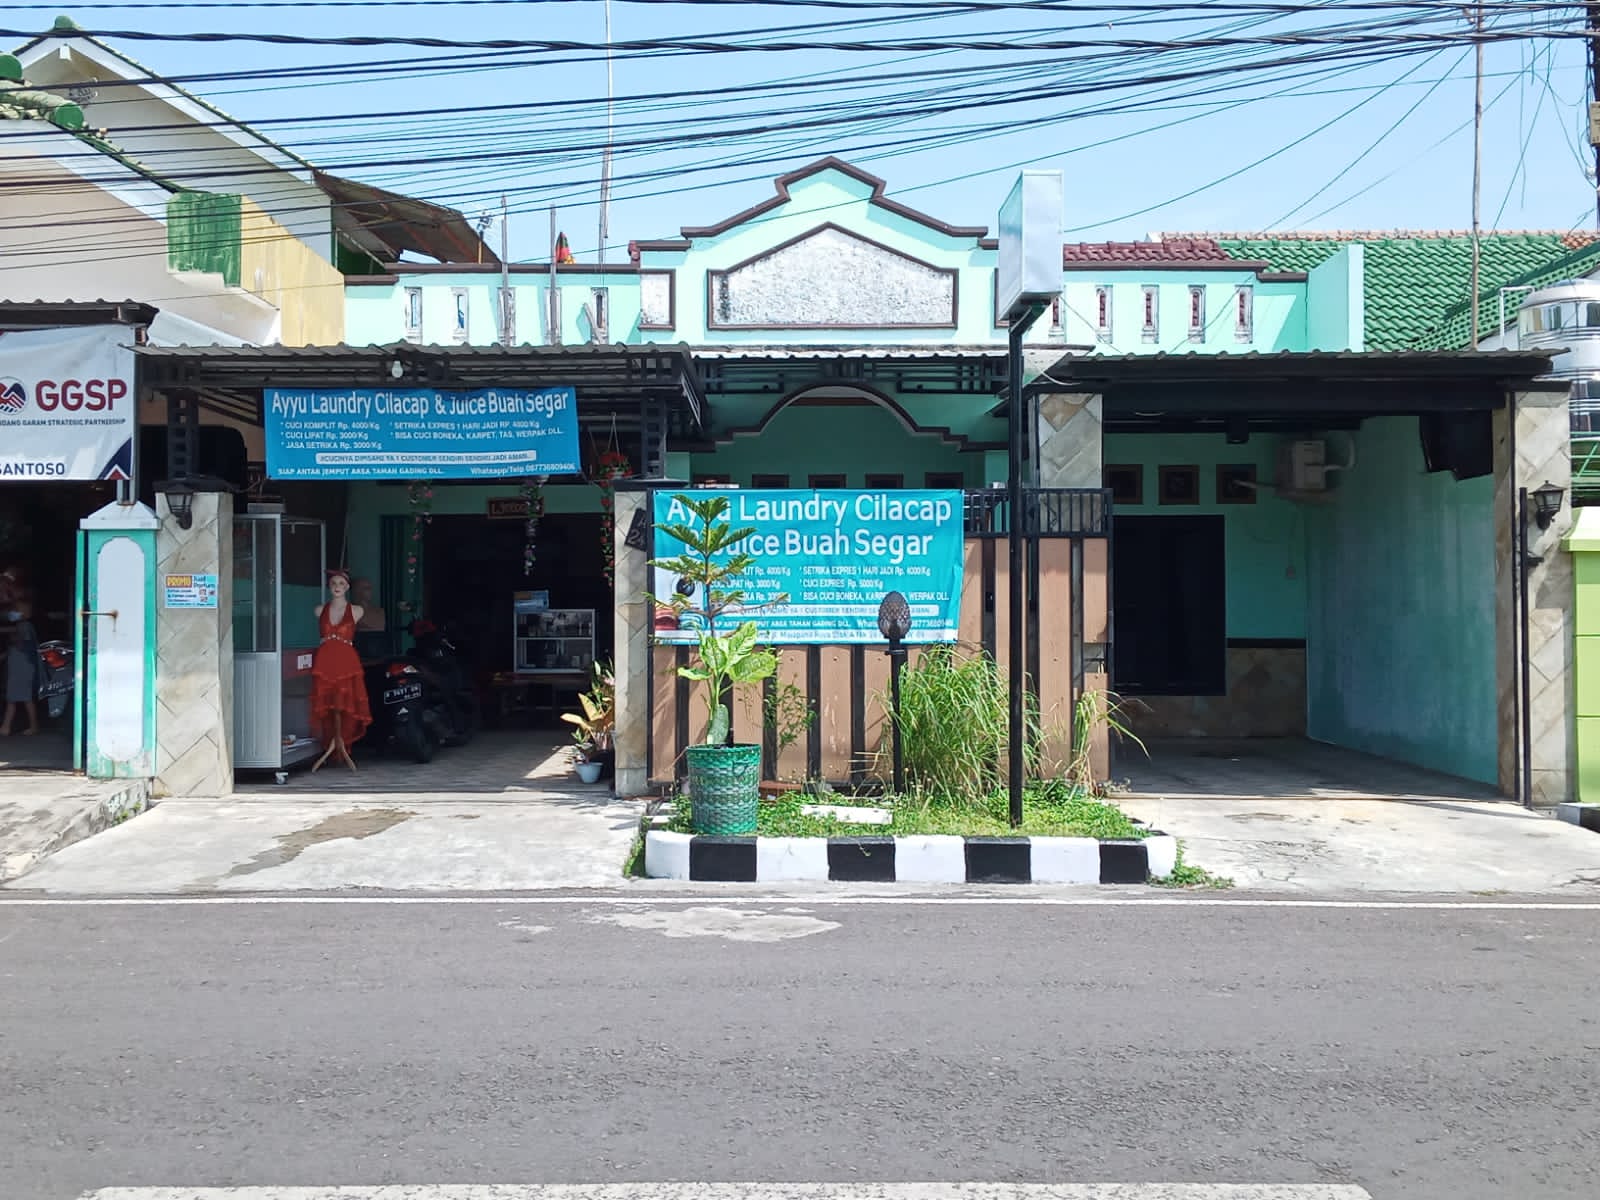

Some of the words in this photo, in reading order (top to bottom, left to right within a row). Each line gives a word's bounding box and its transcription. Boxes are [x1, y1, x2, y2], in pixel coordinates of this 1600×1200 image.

[35, 378, 127, 411] GGSP
[272, 391, 307, 418] Ayyu
[311, 391, 371, 418] Laundry
[375, 392, 429, 418] Cilacap
[435, 394, 447, 415] &
[449, 396, 486, 415] Juice
[488, 391, 524, 414] Buah
[526, 392, 568, 418] Segar
[0, 462, 65, 476] ANTOSO
[739, 493, 848, 526] Laundry
[855, 493, 952, 527] Cilacap
[784, 528, 849, 556] Buah
[854, 528, 933, 564] Segar
